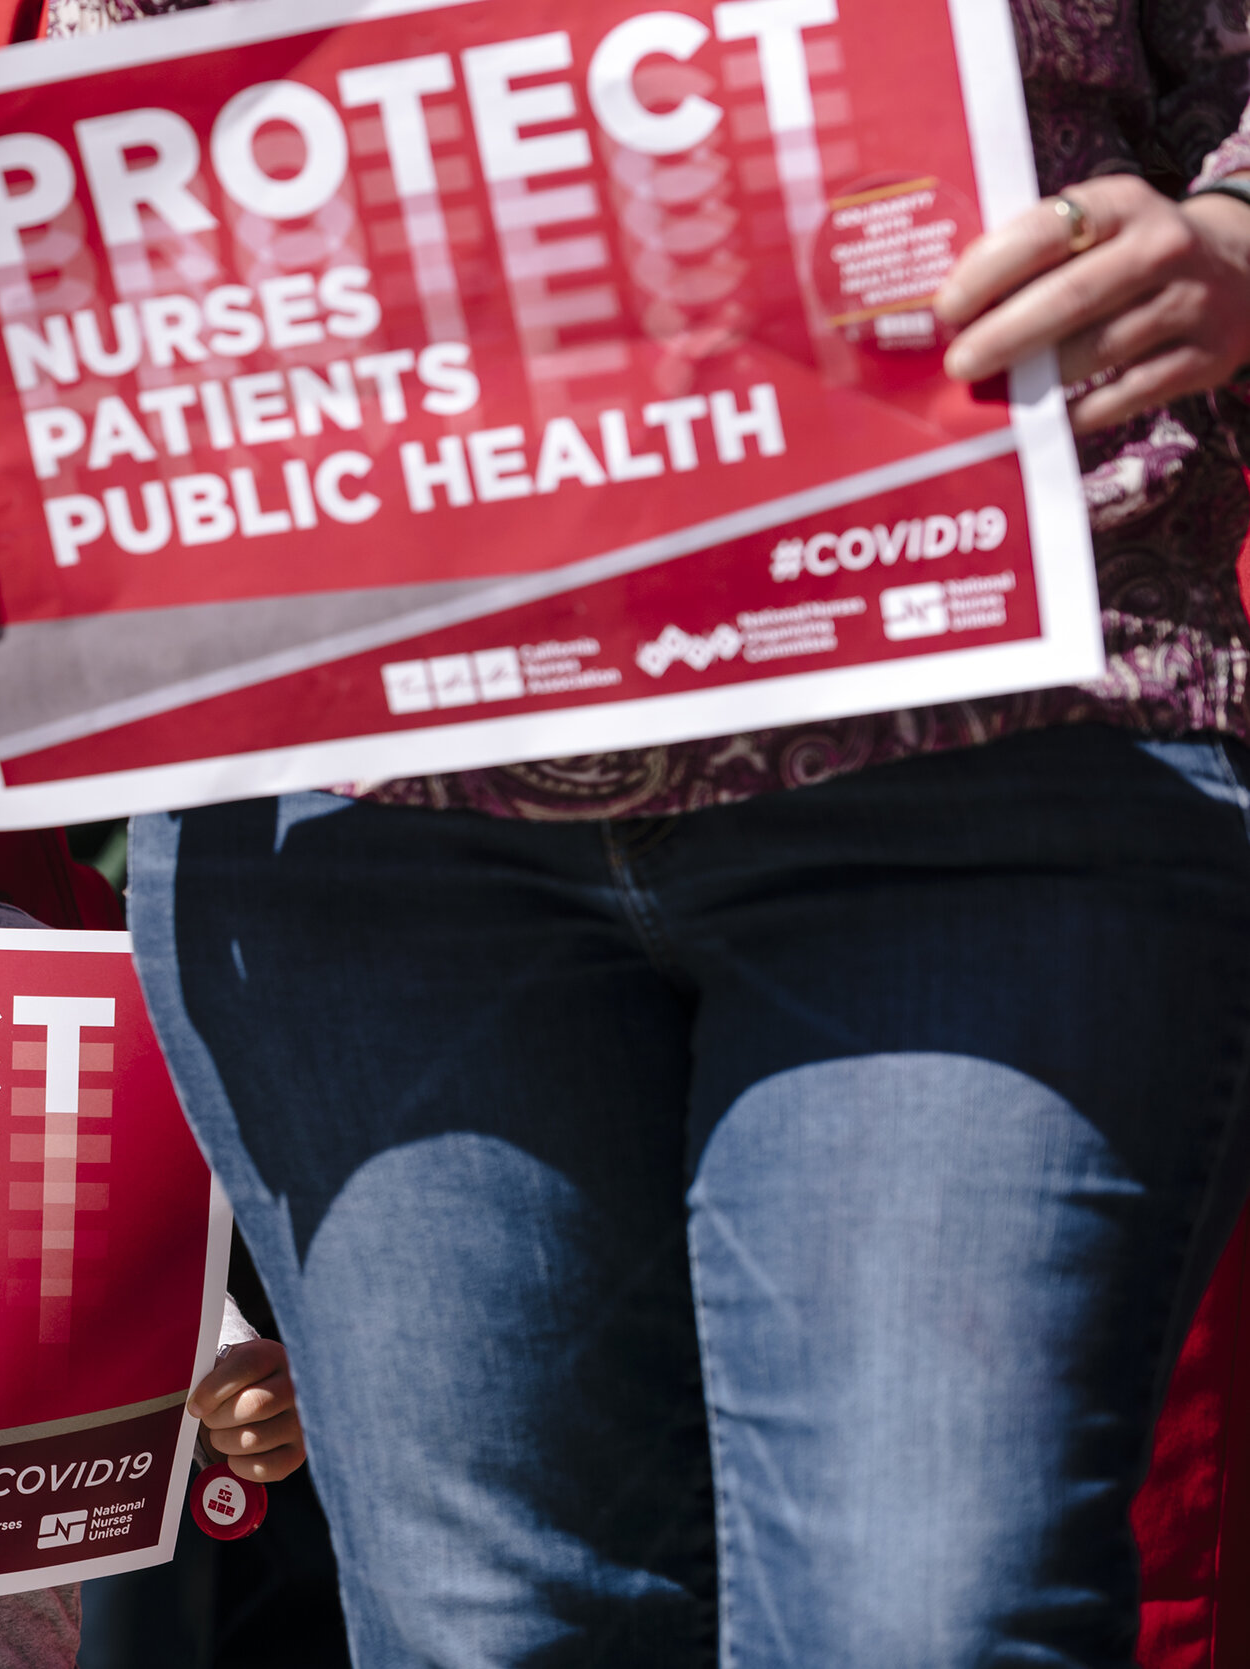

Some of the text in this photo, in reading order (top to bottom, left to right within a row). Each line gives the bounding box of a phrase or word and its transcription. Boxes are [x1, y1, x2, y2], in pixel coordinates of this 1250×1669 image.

[3, 265, 382, 391] NURSES
[25, 341, 480, 480] PATIENTS
[44, 384, 786, 569] PUBLIC HEALTH
[768, 505, 1009, 582] #COVID19
[88, 1524, 130, 1541] United
[90, 1513, 133, 1530] Nurses
[92, 1498, 146, 1518] National
